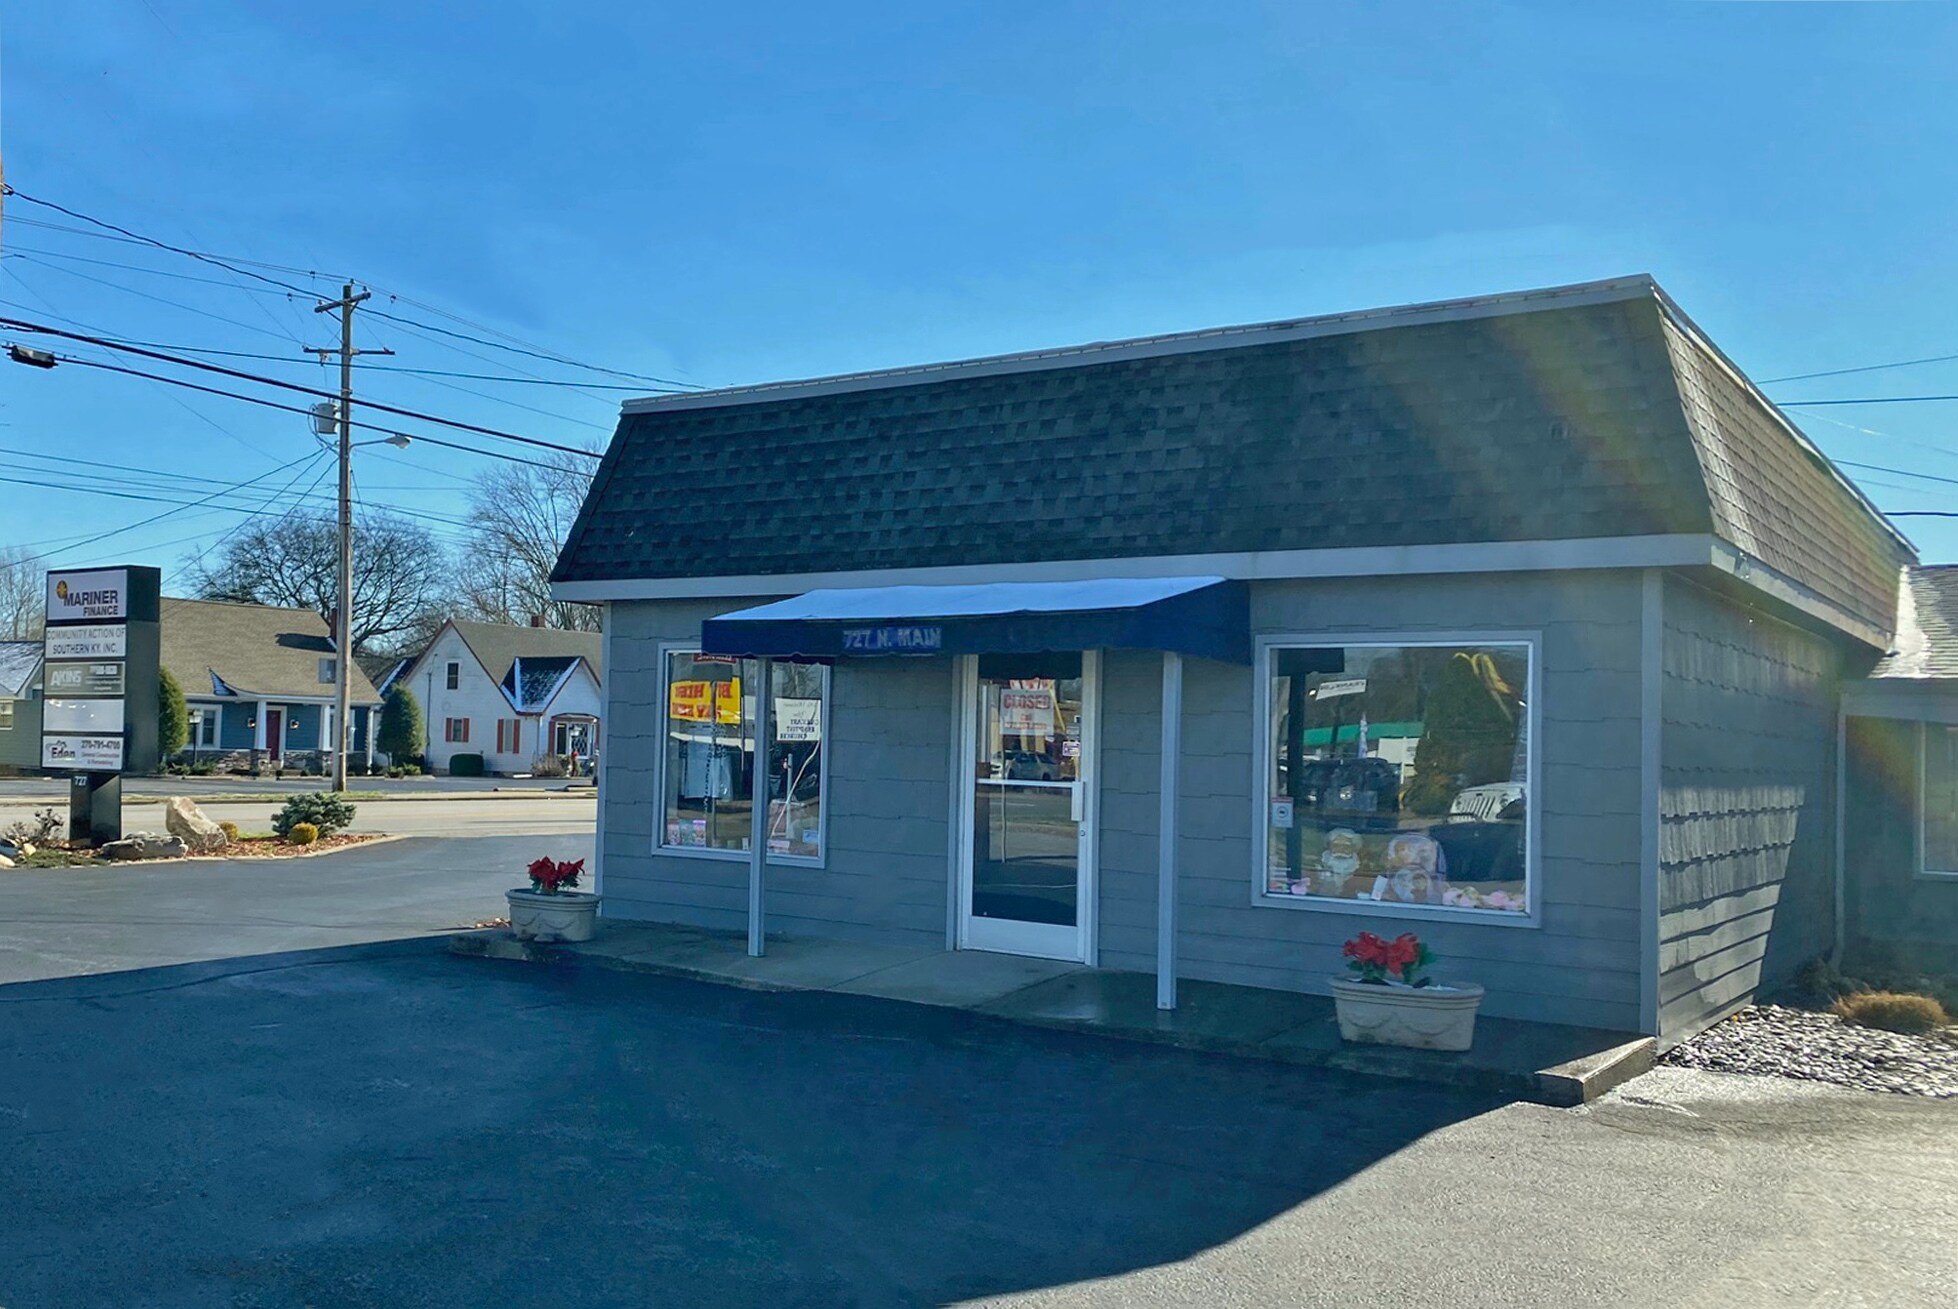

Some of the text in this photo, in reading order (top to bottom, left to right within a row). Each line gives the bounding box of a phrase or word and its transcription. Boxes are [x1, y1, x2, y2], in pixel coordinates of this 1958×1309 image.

[63, 590, 119, 606] MARINER
[83, 605, 119, 616] FINANCE
[47, 629, 87, 640] COMMUNITY
[88, 628, 114, 638] ACTION
[898, 627, 942, 648] MAIN
[53, 643, 89, 654] SOUTHERN
[50, 670, 82, 686] AKINS
[1004, 694, 1050, 709] CLOSED
[51, 747, 76, 758] Eden
